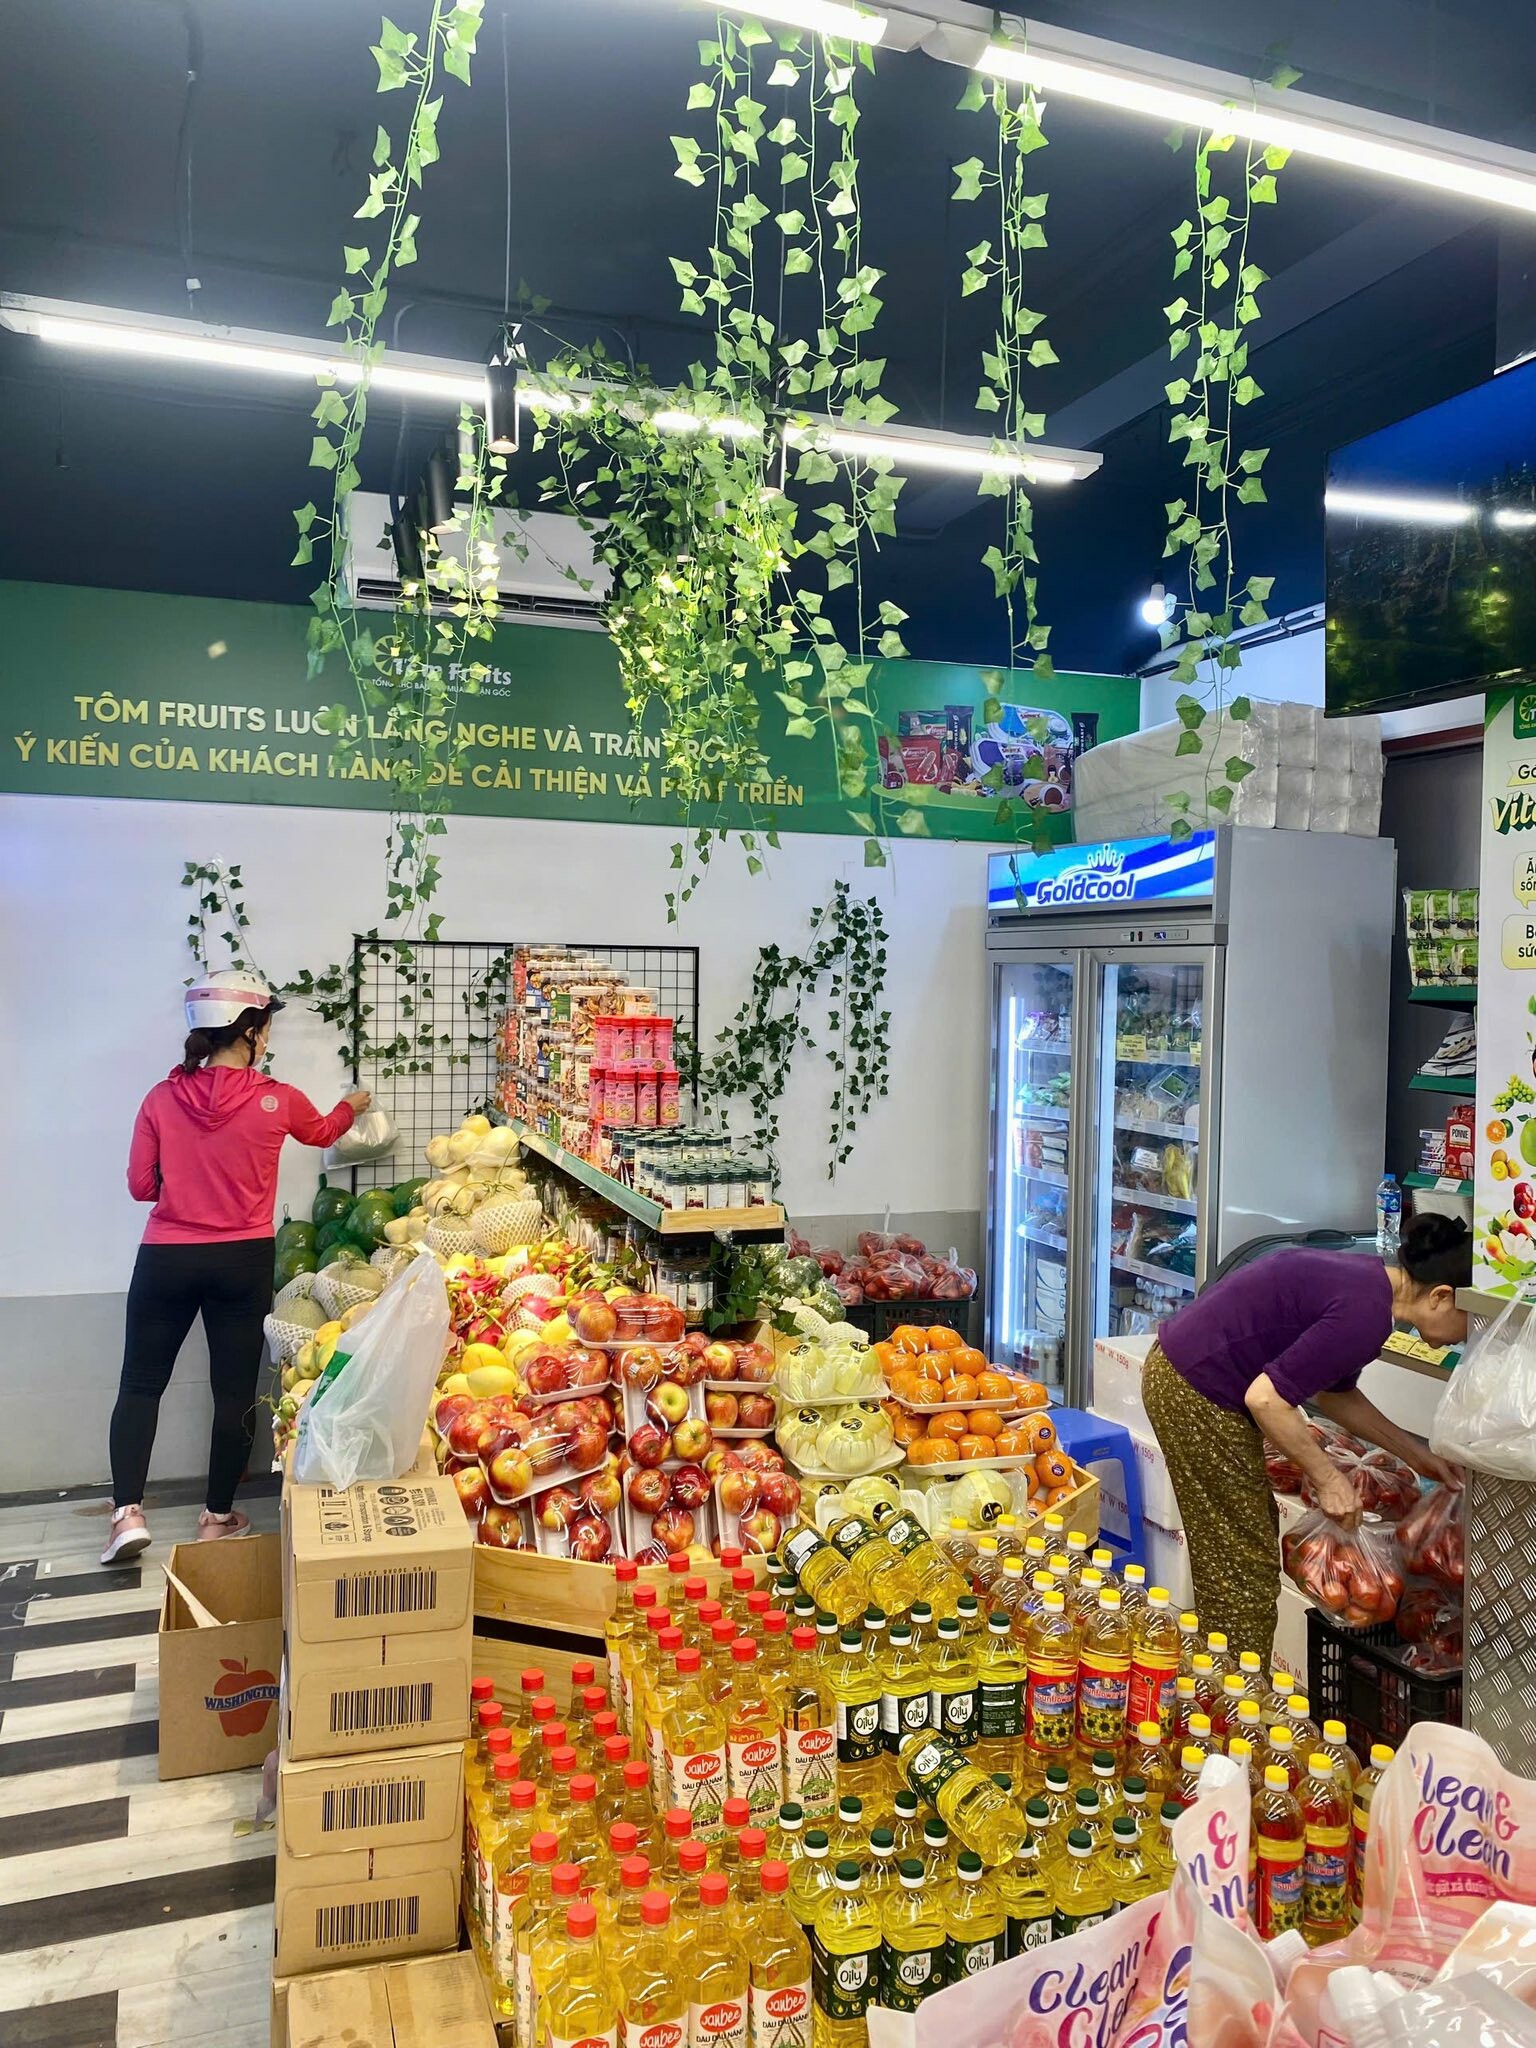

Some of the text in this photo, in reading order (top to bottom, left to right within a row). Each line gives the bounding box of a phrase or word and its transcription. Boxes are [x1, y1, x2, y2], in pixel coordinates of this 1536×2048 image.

[449, 662, 512, 685] Frits
[74, 690, 149, 725] TÔM
[159, 701, 267, 733] FRUITS
[457, 721, 536, 752] NGHE
[543, 724, 583, 753] VÀ
[14, 730, 37, 763] Ý
[47, 732, 119, 768] KIẾN
[129, 737, 200, 772] CỦA
[209, 744, 318, 779] KHÁCH
[471, 758, 521, 790] CẢI
[530, 765, 607, 801] THIỆN
[734, 775, 804, 807] TRIỂN
[1488, 791, 1536, 834] Vit
[1036, 873, 1135, 905] Goldcool
[890, 1529, 907, 1542] Oily
[907, 1708, 924, 1723] Oily
[950, 1705, 968, 1720] Oily
[855, 1716, 874, 1733] Oily
[918, 1755, 939, 1772] Oily
[1410, 1753, 1520, 1841] lean &
[1413, 1805, 1511, 1880] Clean
[840, 1969, 862, 1986] Oily
[903, 1965, 925, 1981] Oily
[1029, 1941, 1141, 2015] Clean
